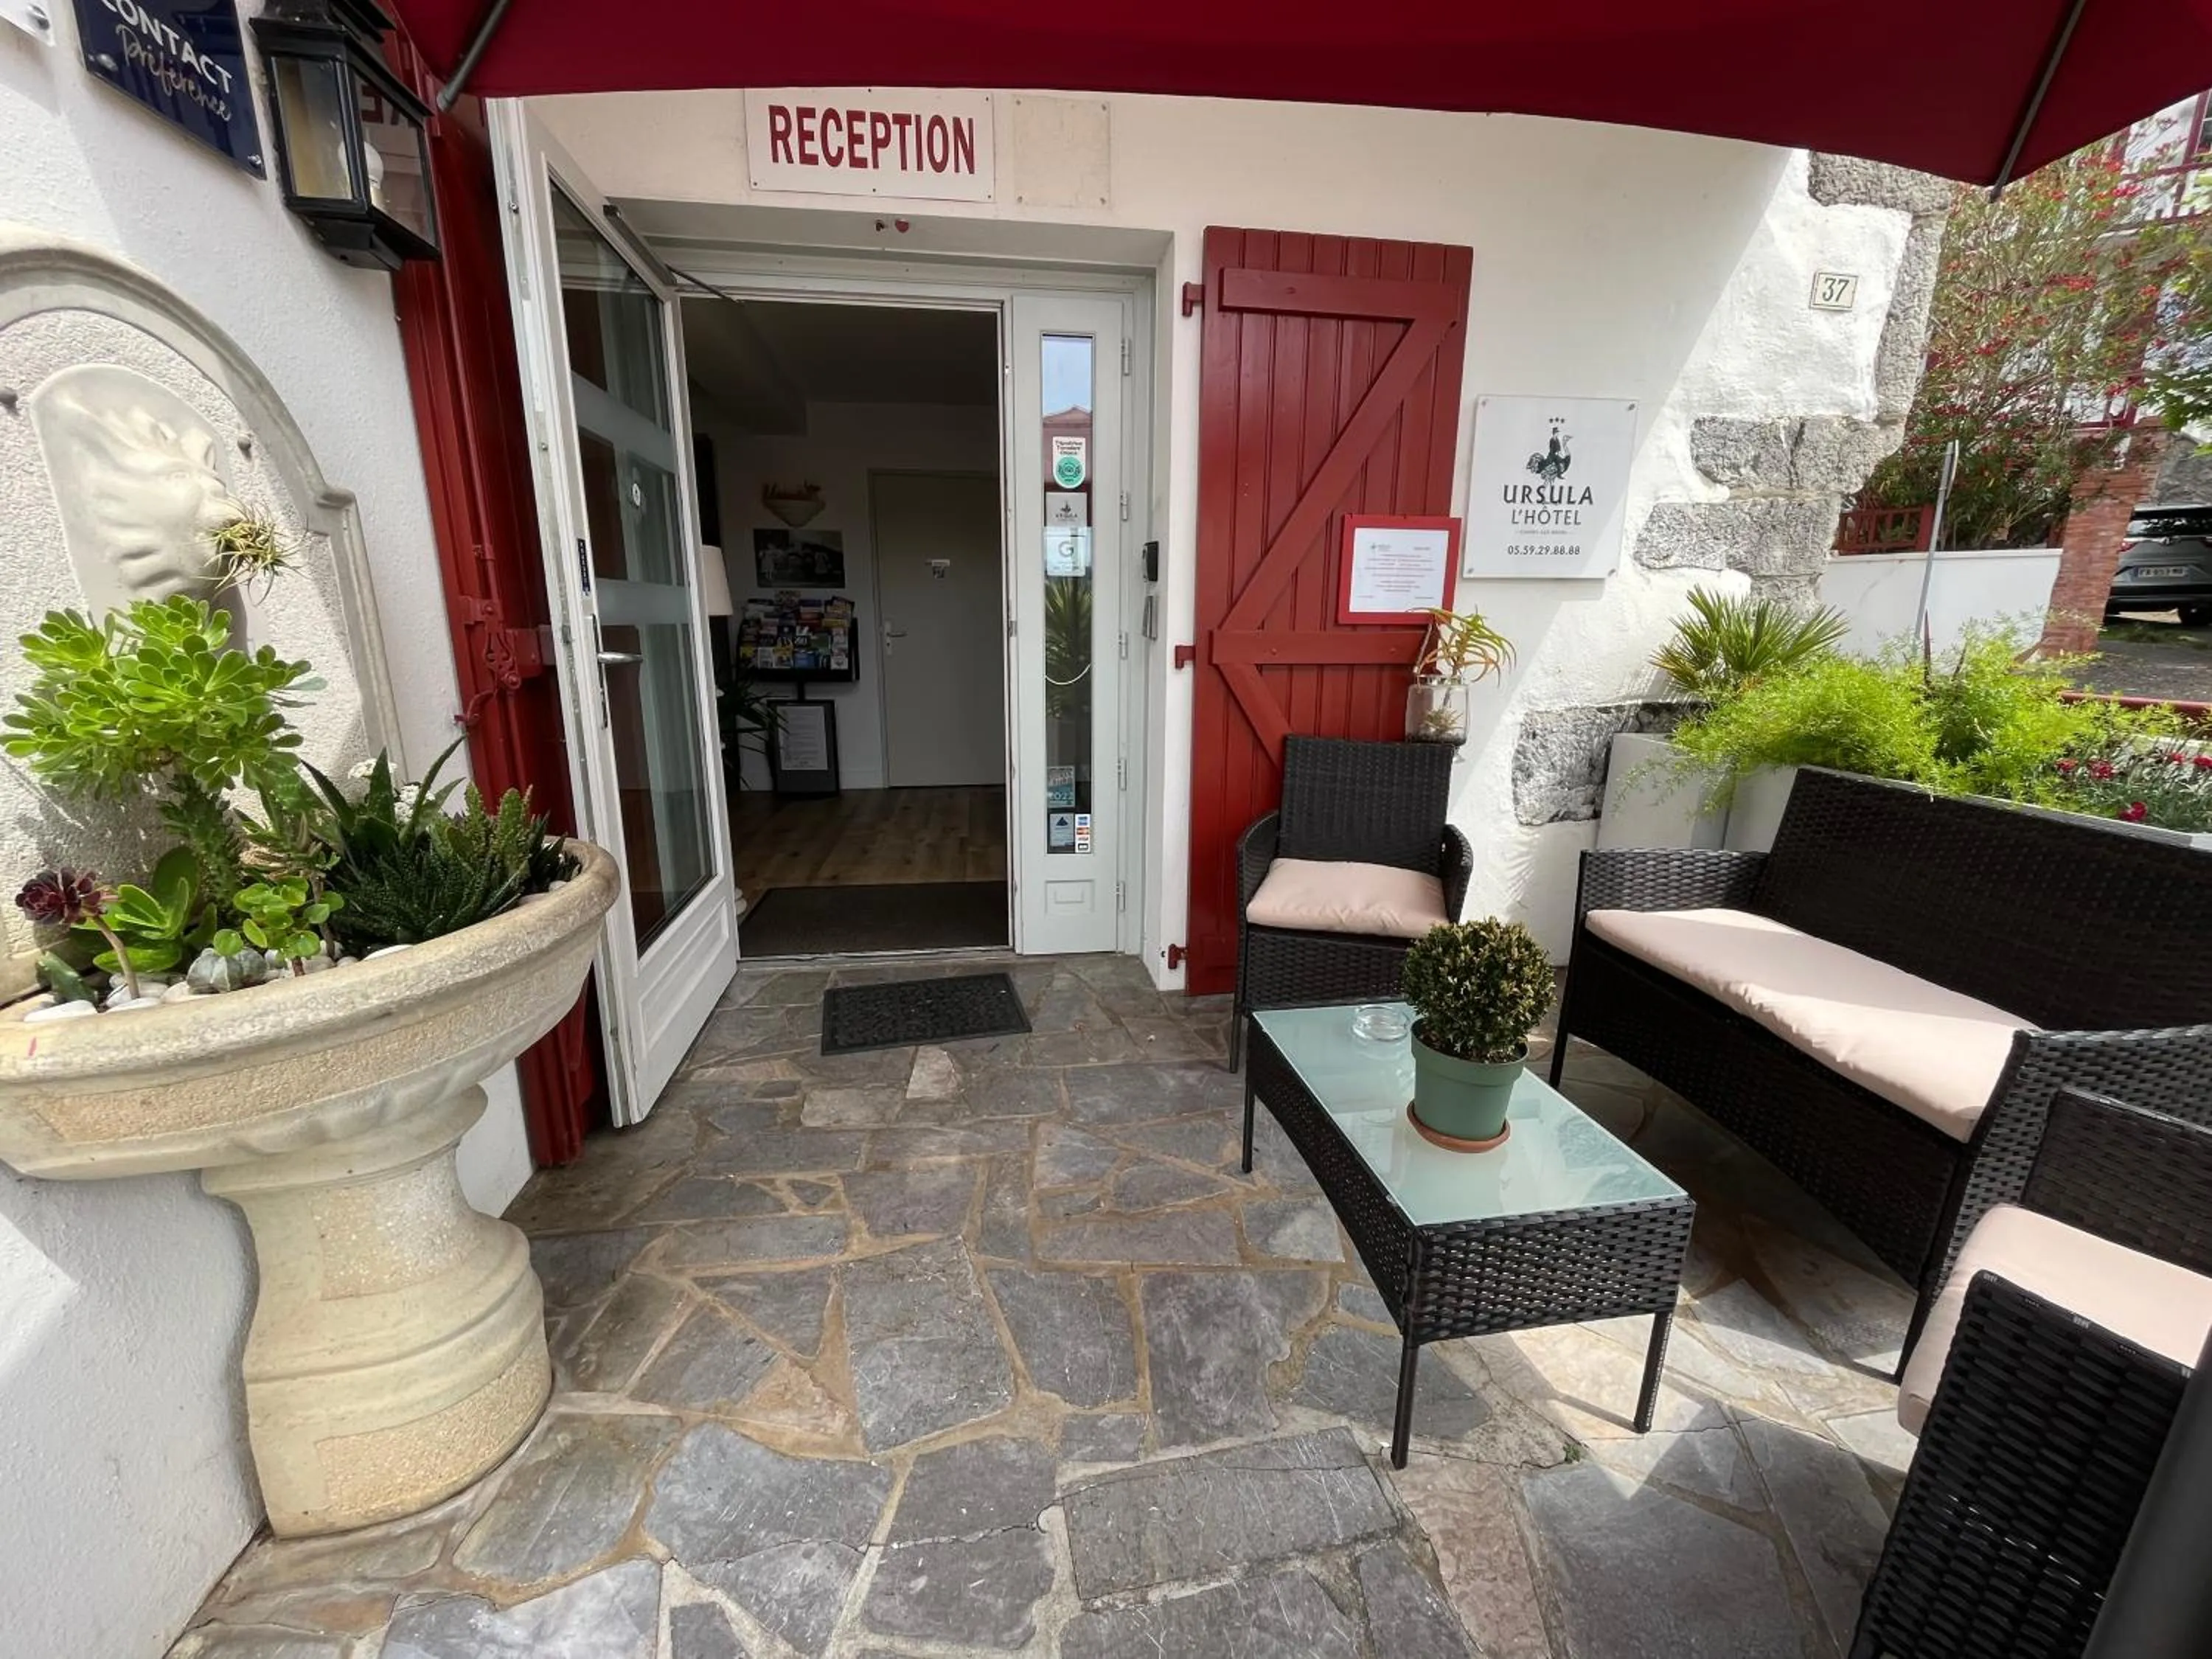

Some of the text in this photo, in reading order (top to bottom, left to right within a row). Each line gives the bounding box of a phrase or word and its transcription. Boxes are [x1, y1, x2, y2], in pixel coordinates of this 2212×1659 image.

[768, 105, 975, 175] RECEPTION
[1822, 277, 1850, 302] 37
[1503, 484, 1593, 505] URSULA
[1512, 506, 1582, 526] L'HÔTEL
[1508, 545, 1580, 555] 05.59.29.88.88
